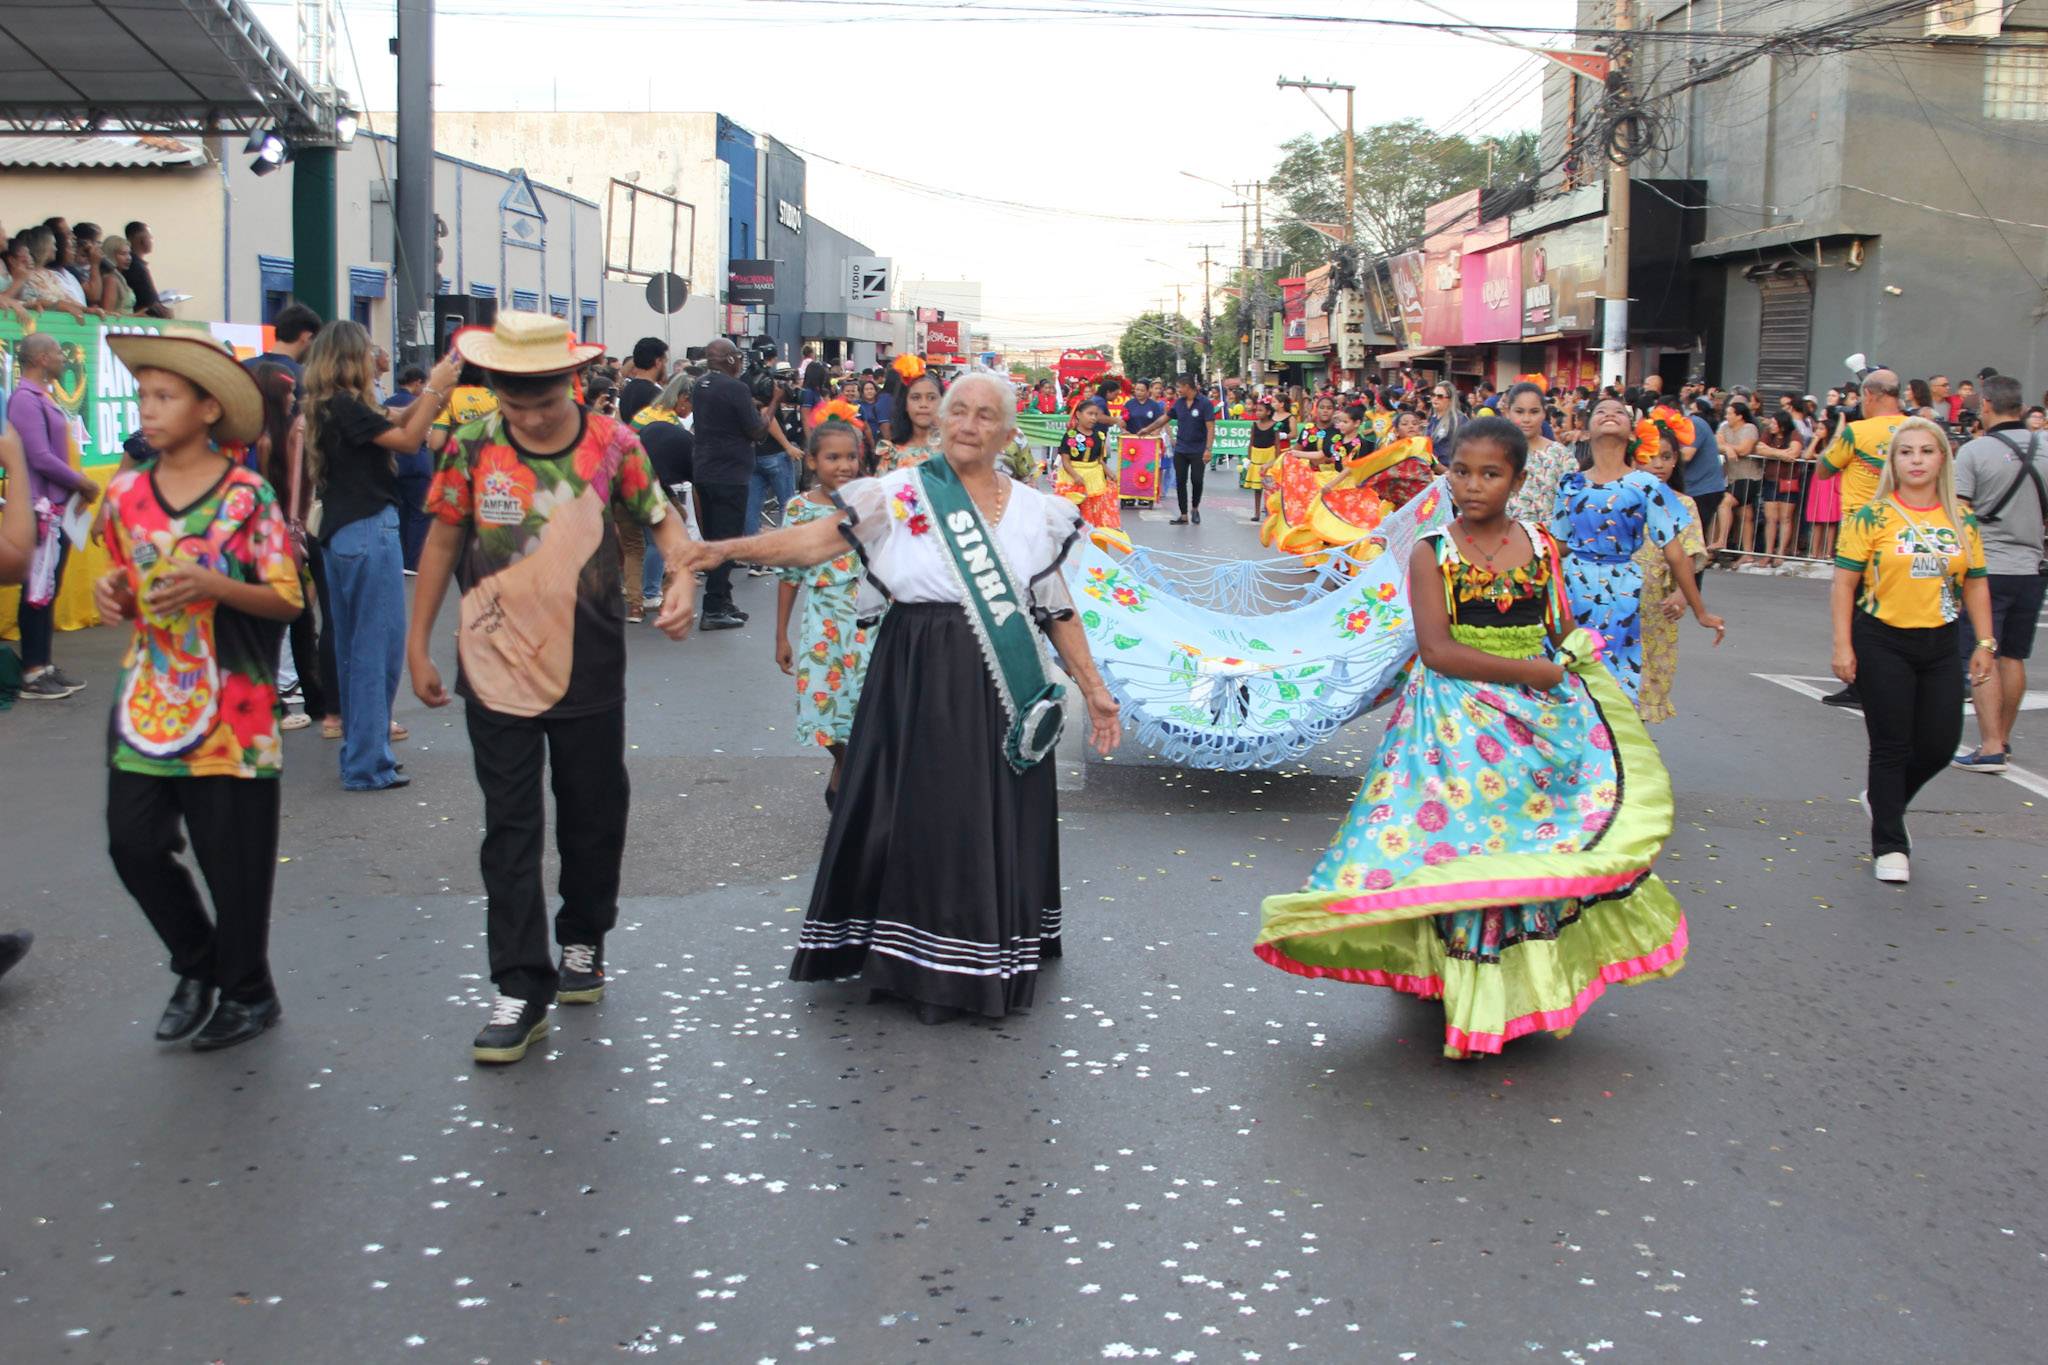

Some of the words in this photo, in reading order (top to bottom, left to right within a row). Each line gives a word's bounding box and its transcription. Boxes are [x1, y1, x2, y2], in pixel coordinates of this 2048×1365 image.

[852, 264, 860, 300] STUDIO
[98, 402, 124, 455] DE
[947, 510, 1017, 627] SINHA
[1912, 556, 1949, 571] ANOS
